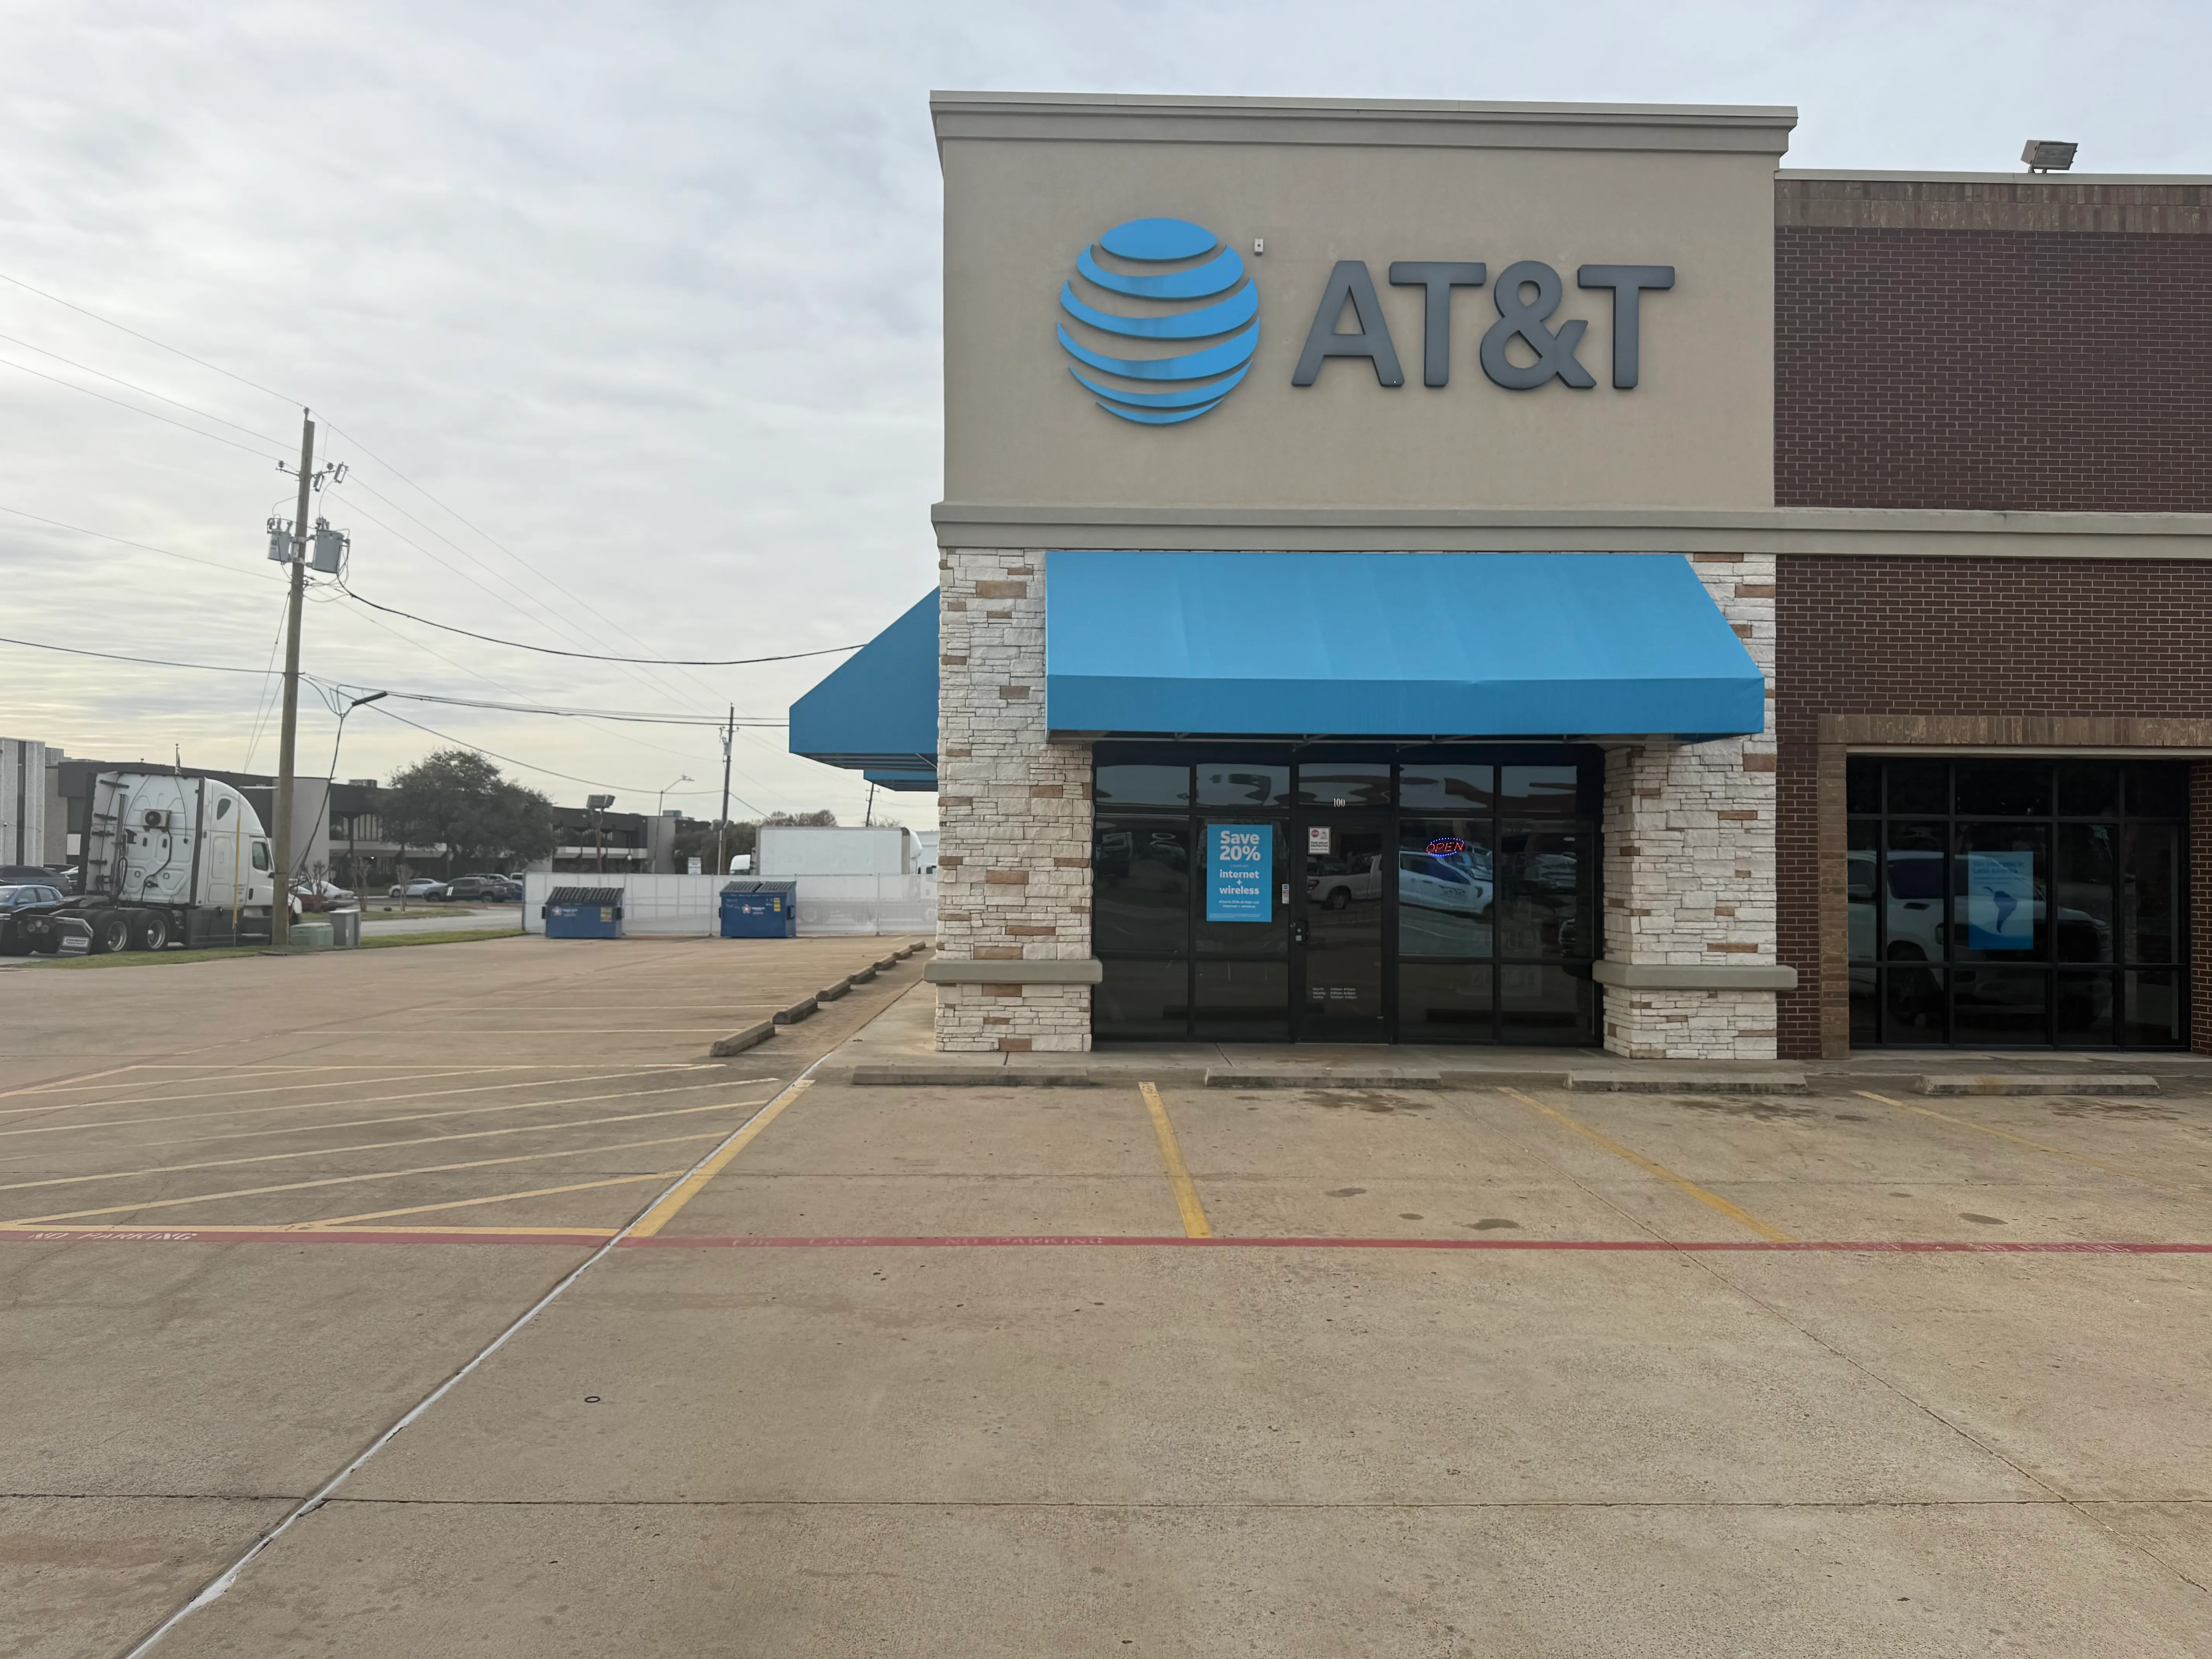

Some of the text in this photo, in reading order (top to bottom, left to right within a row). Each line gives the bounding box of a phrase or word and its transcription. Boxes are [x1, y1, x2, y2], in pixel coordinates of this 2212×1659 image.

[1291, 260, 1676, 391] AT&T
[1333, 797, 1345, 808] 100
[1220, 830, 1260, 845] Save
[1219, 845, 1261, 861] 20%
[1426, 842, 1465, 854] OPEN
[1219, 869, 1259, 879] internet
[1219, 885, 1260, 895] wireless
